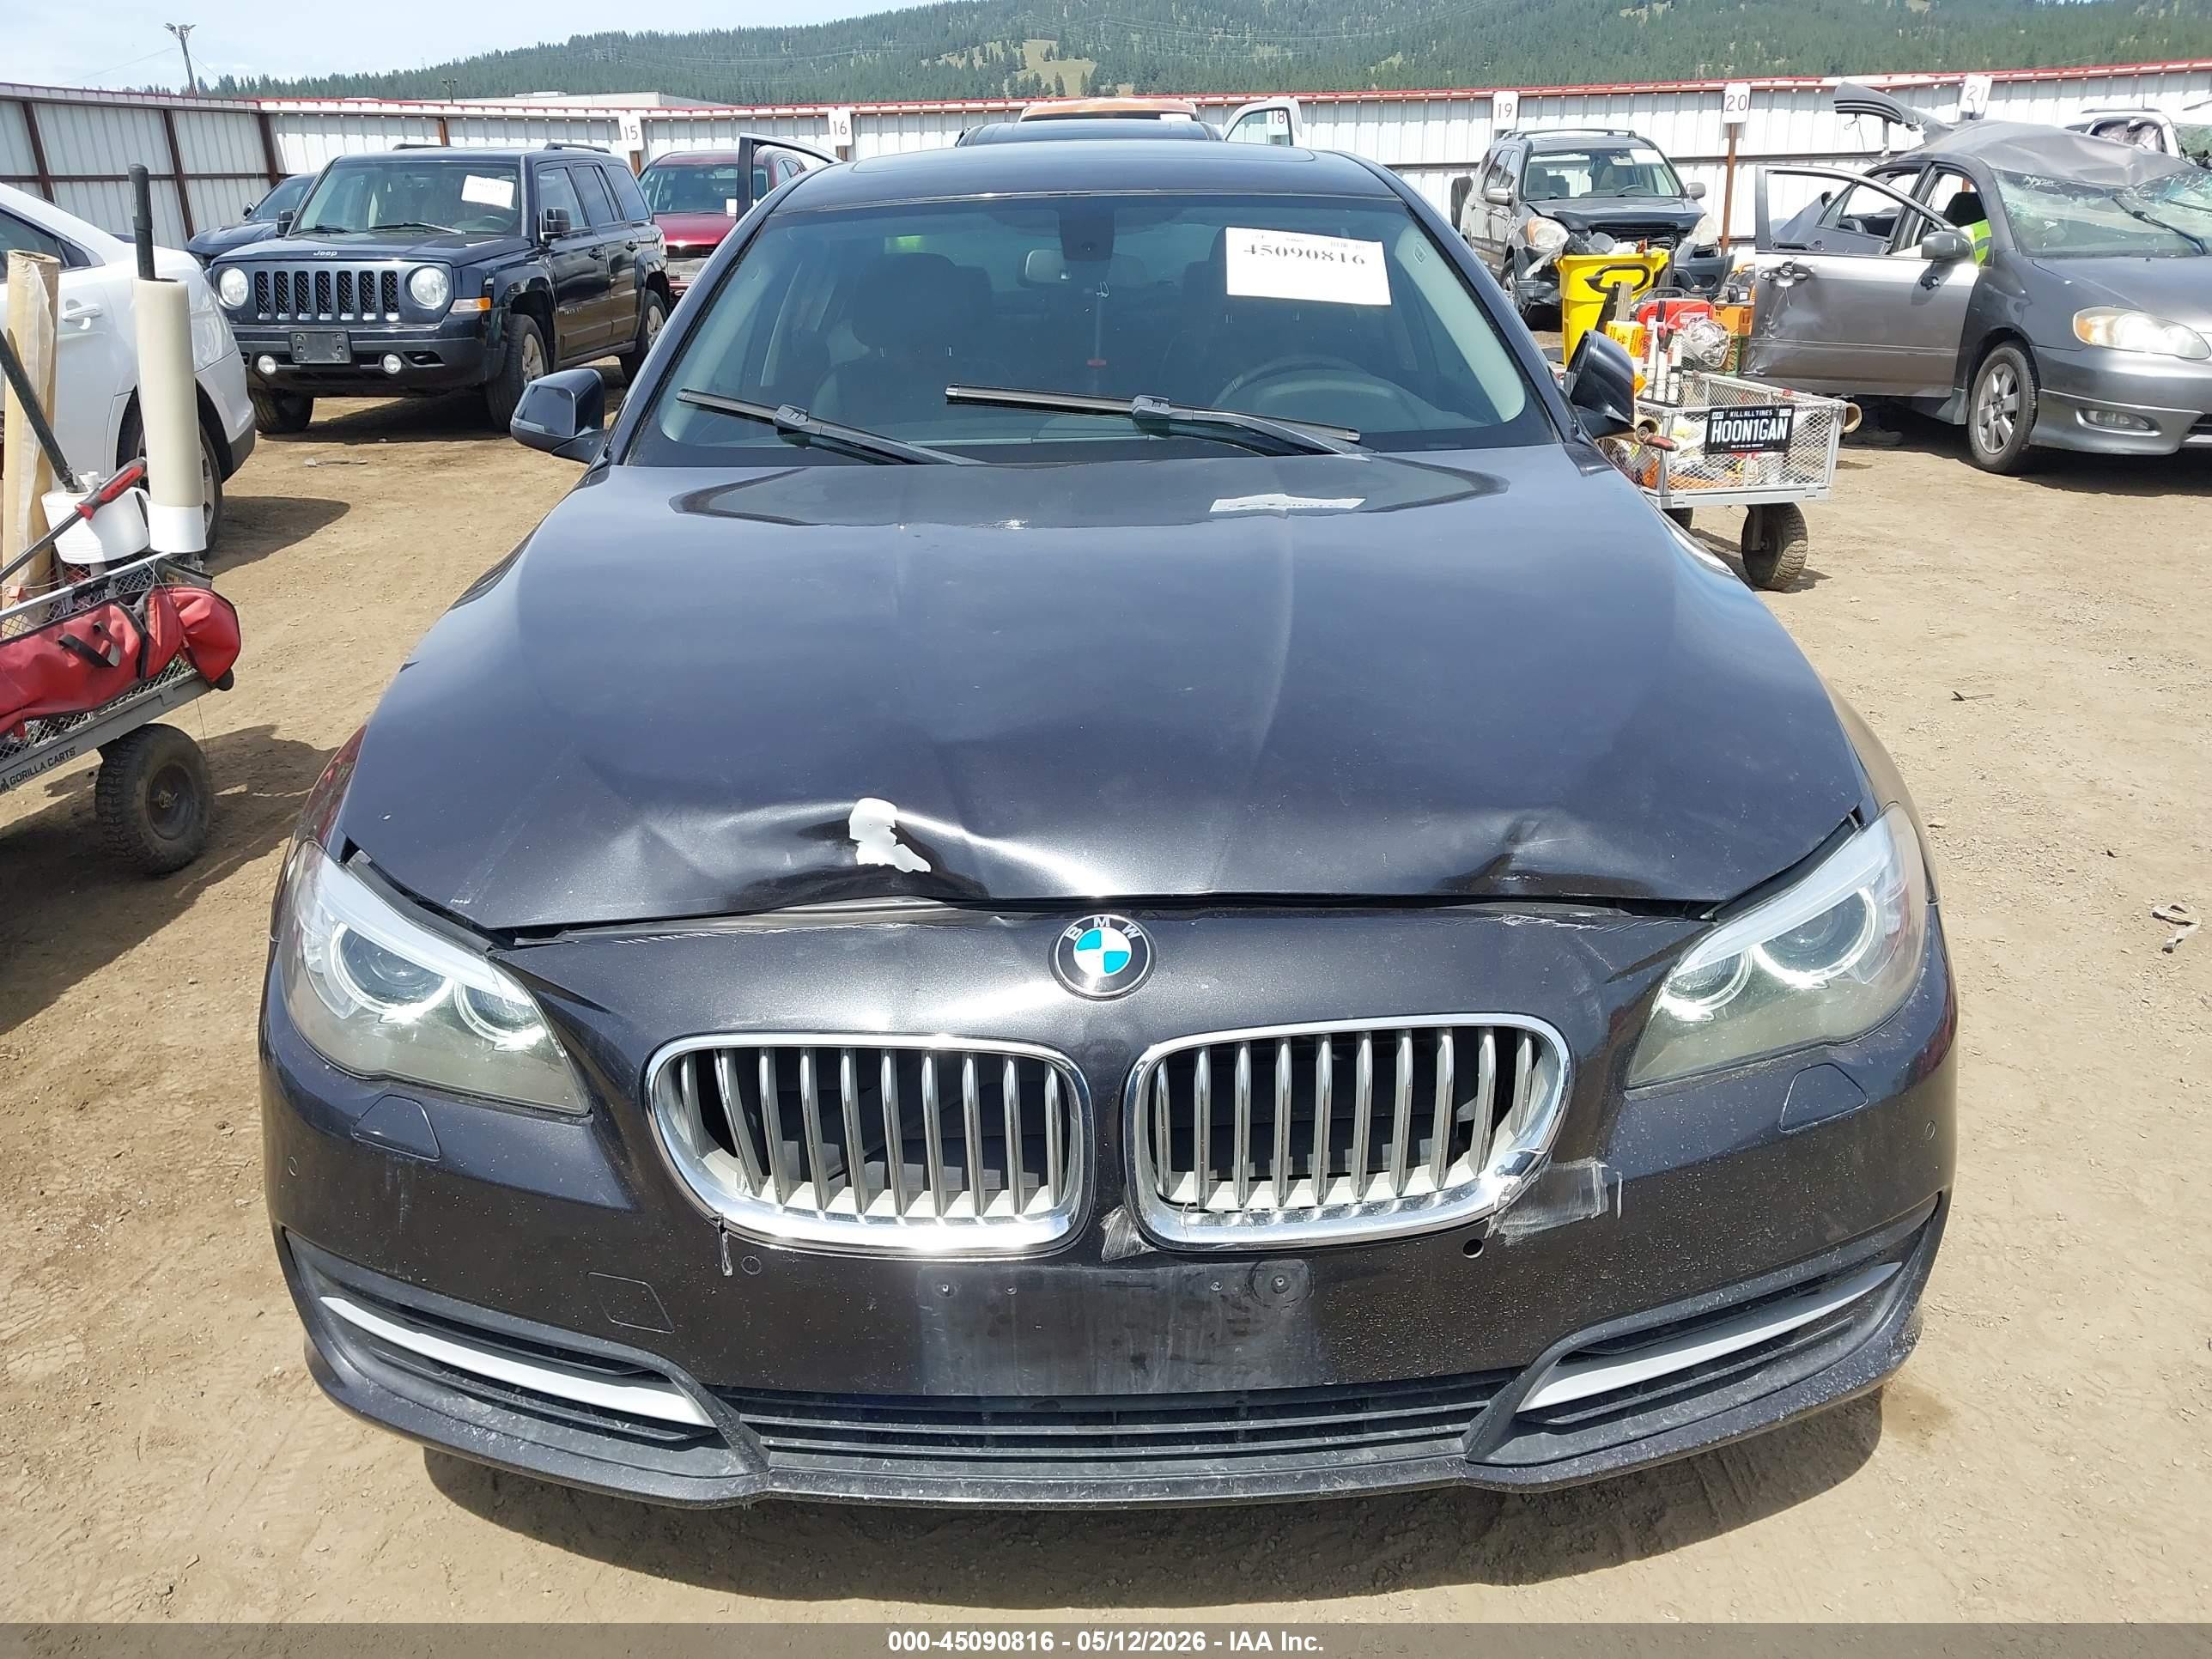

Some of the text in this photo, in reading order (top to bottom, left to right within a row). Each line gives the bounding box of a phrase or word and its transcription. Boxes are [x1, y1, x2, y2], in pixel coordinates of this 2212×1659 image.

[1966, 85, 1985, 101] 21
[1498, 102, 1512, 118] 19
[1725, 94, 1747, 112] 20
[1271, 110, 1285, 125] 18
[624, 125, 638, 140] 15
[833, 120, 848, 136] 16
[1243, 244, 1365, 265] 45090816
[1711, 417, 1789, 444] HOON1GAN
[9, 745, 76, 786] GORILLA CARTS
[1065, 916, 1140, 941] BMW
